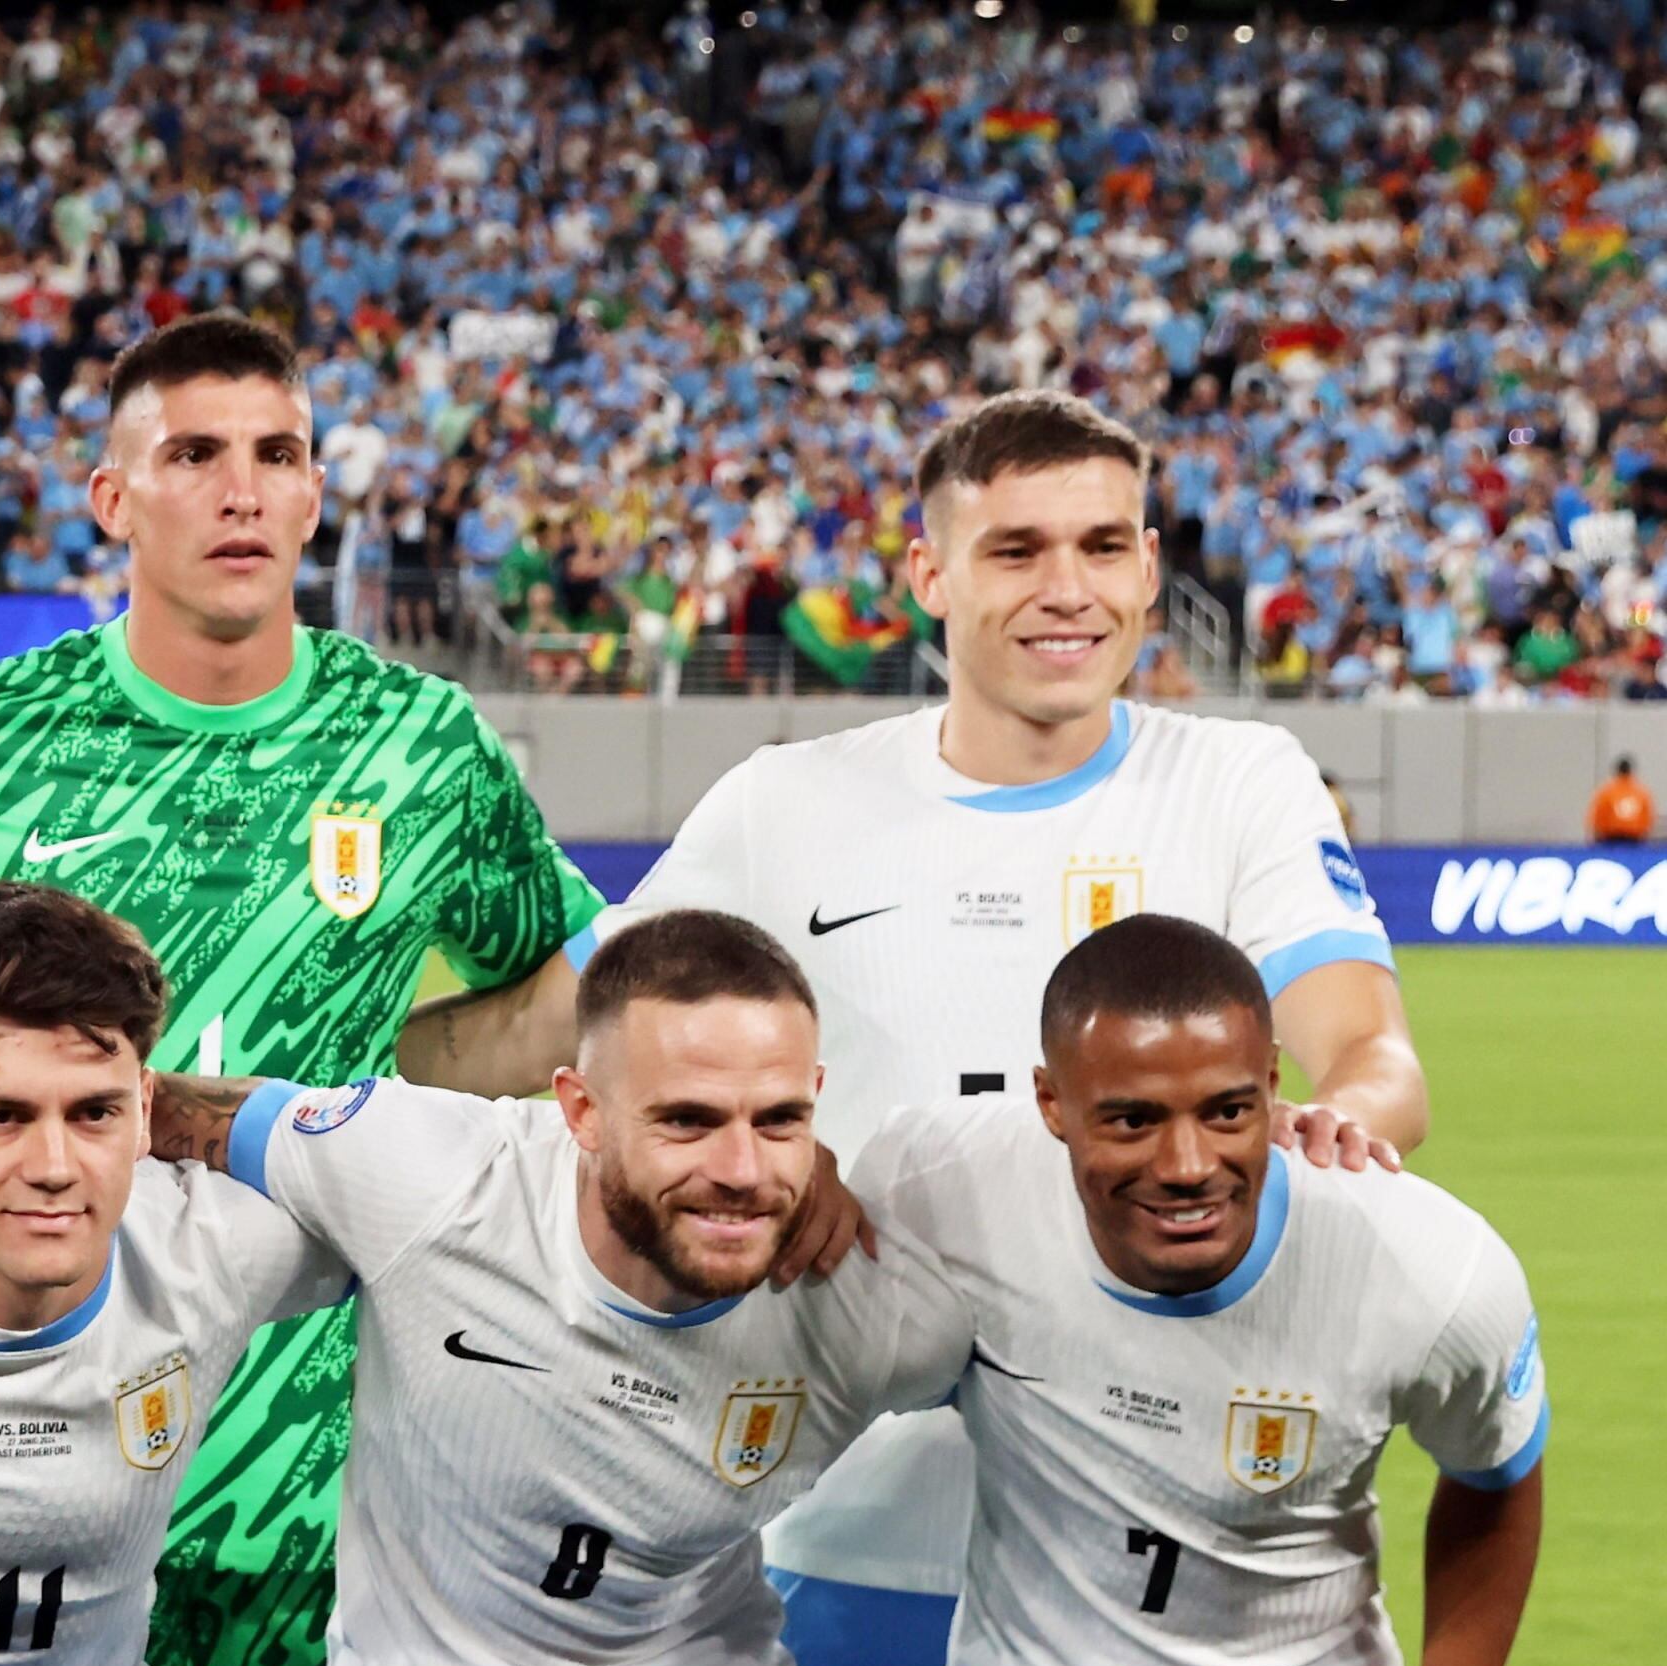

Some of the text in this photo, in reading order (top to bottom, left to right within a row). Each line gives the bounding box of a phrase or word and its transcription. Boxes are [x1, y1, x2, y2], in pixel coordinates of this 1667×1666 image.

[631, 1377, 679, 1404] BOLIVIA
[19, 1421, 68, 1435] BOLIVIA
[539, 1523, 614, 1601] 8
[1128, 1528, 1182, 1613] 7
